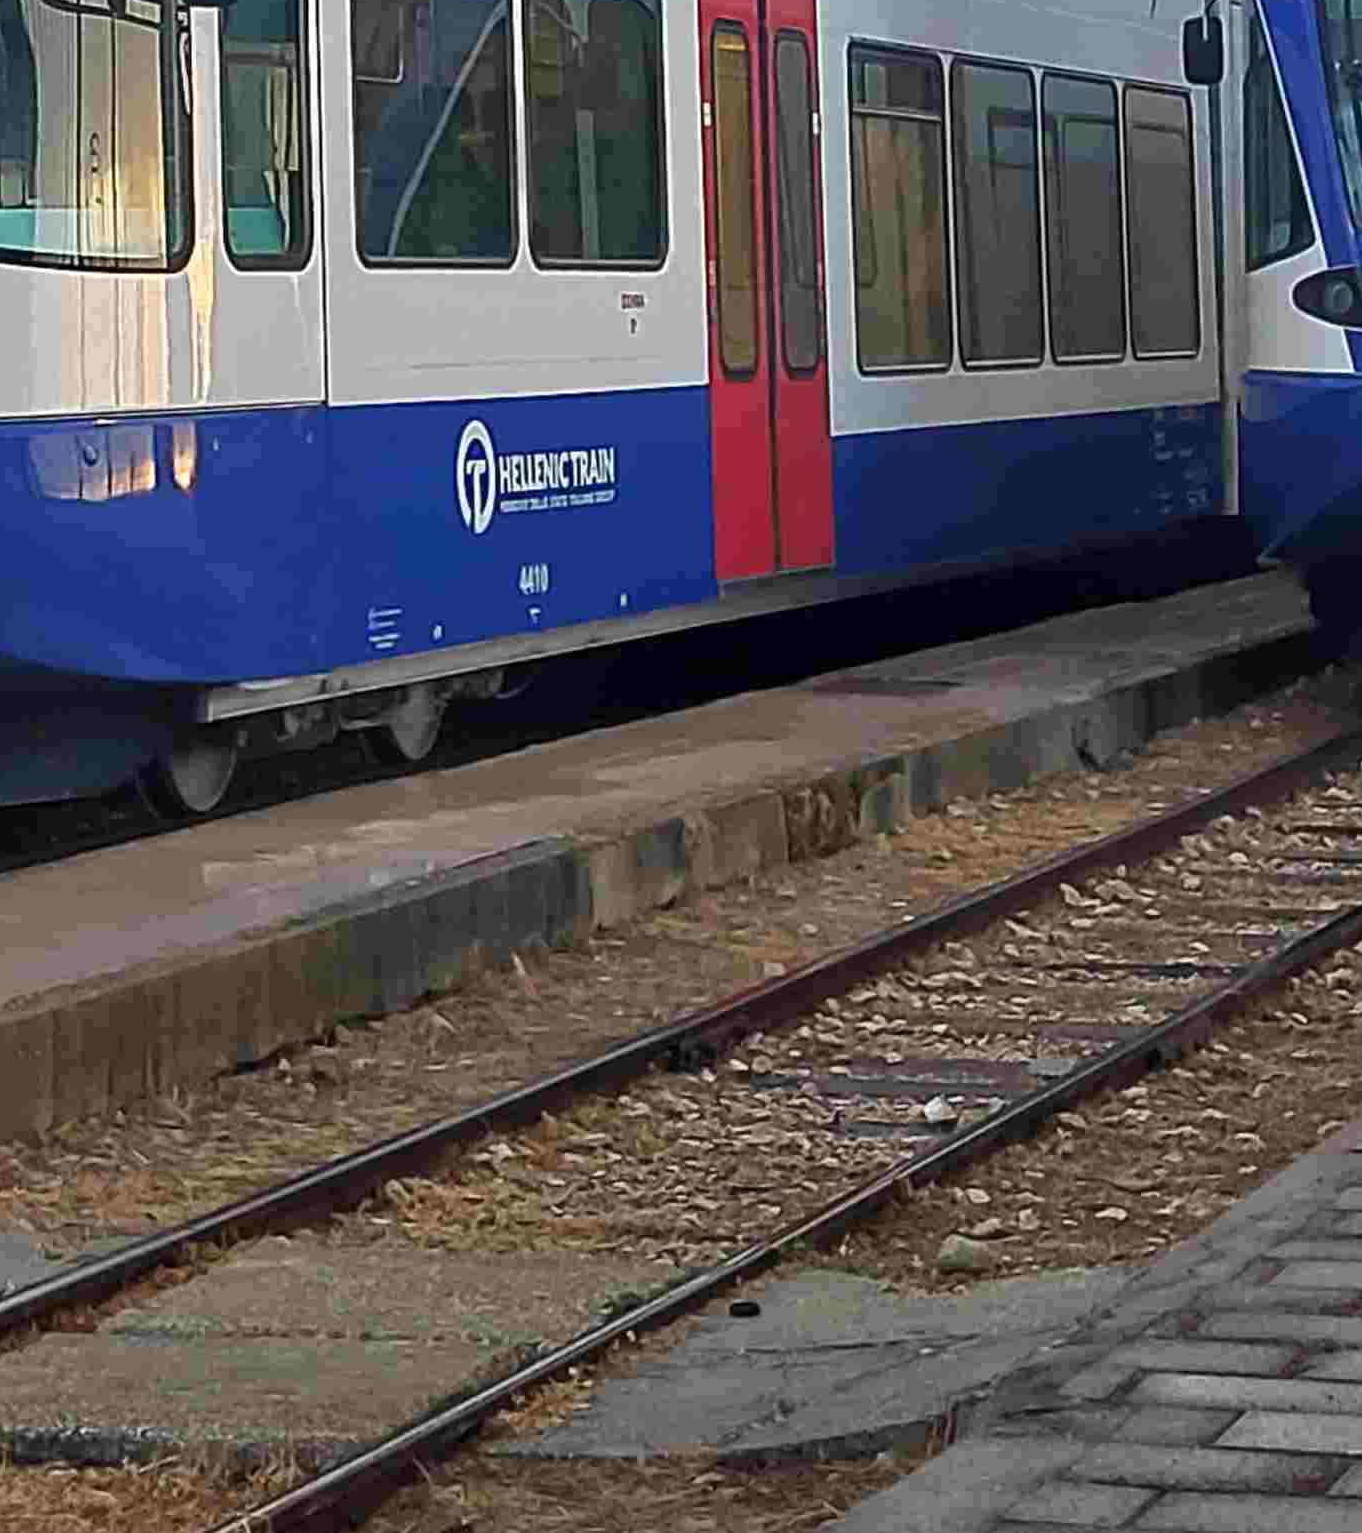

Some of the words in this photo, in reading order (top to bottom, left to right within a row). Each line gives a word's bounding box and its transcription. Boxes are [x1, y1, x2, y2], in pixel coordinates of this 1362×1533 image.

[498, 450, 570, 494] HELLENIC
[570, 447, 615, 487] TRAIN
[519, 564, 549, 595] 4410
